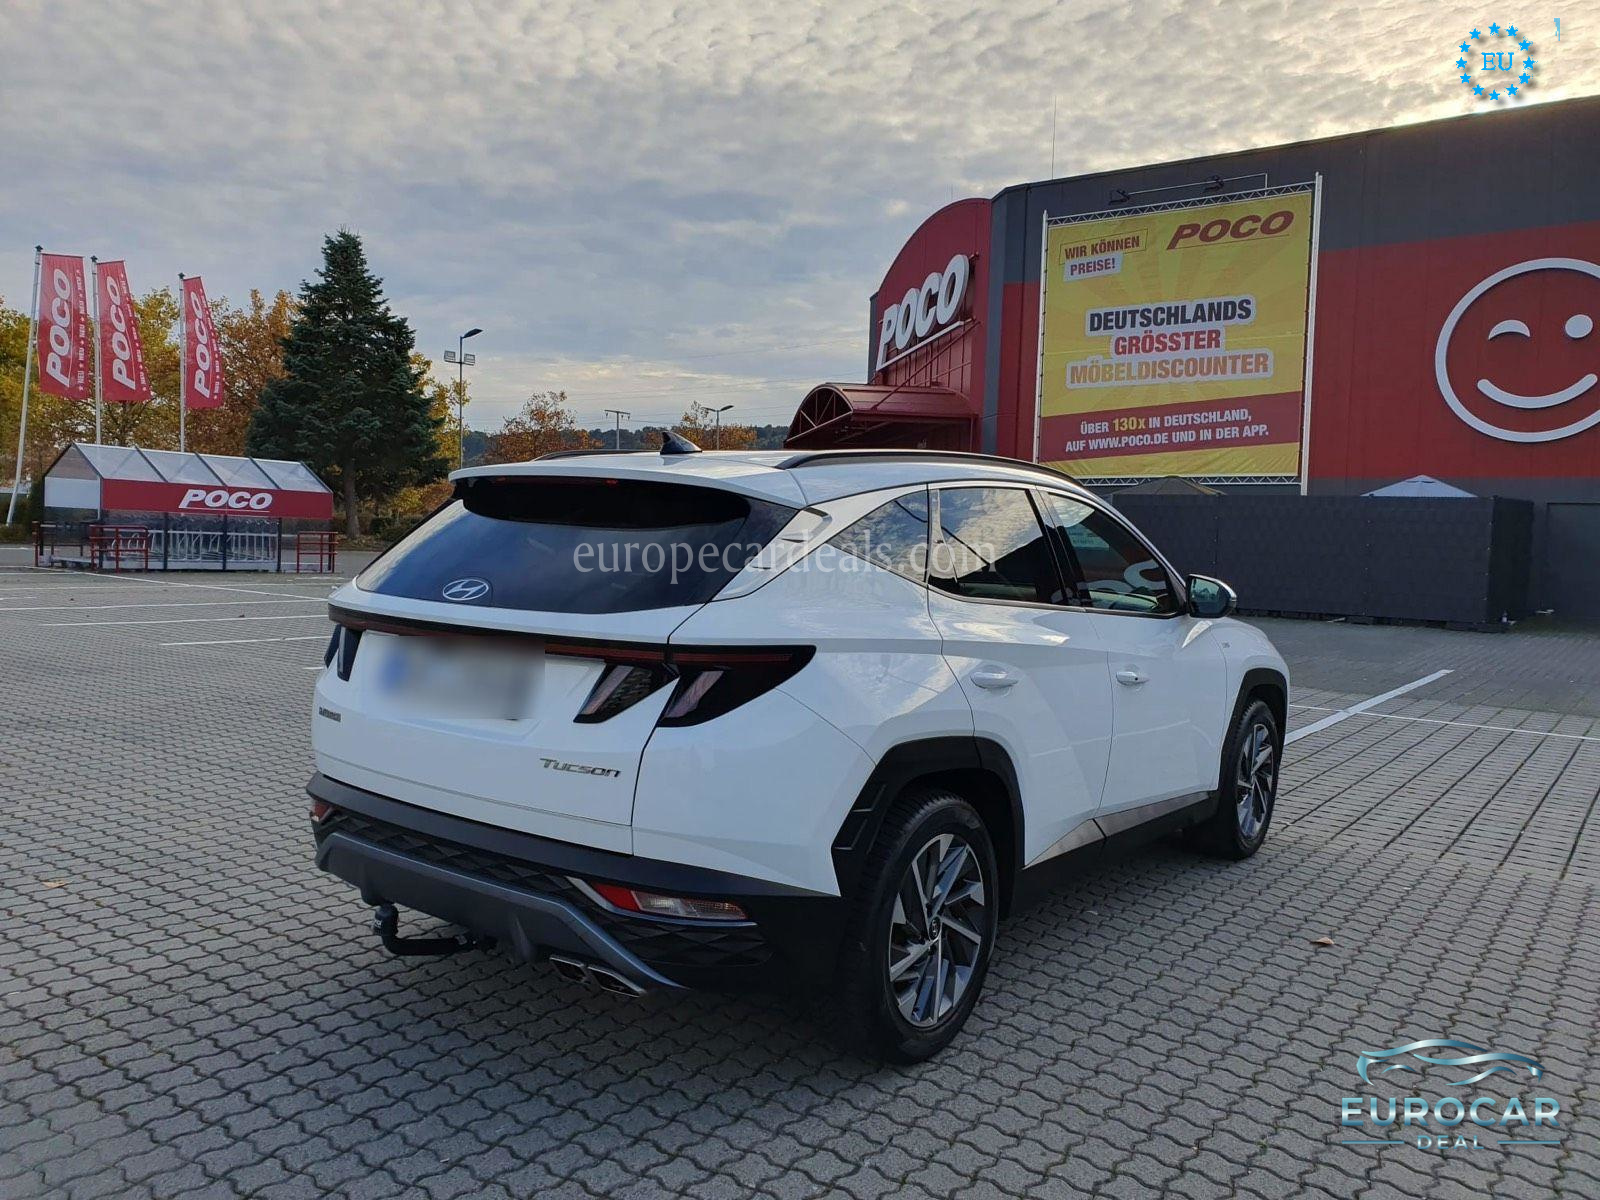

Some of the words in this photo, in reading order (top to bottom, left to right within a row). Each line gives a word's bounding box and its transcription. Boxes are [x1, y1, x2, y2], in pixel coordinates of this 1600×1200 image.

[1167, 210, 1295, 250] POCO
[1064, 245, 1087, 260] WIR
[1091, 235, 1140, 256] KÖNNEN
[1070, 257, 1116, 276] PREISE!
[46, 268, 71, 388] POCO
[876, 254, 970, 372] POCO
[1089, 298, 1252, 332] DEUTSCHLANDS
[106, 275, 136, 390] POCO
[190, 291, 211, 399] POCO
[1114, 329, 1221, 356] GRÖSSTER
[1070, 352, 1269, 384] MÖBELDISCOUNTER
[1080, 421, 1109, 435] ÜBER
[1112, 416, 1146, 432] 130x
[1149, 416, 1160, 428] IN
[1164, 408, 1252, 427] DEUTSCHLAND,
[1065, 440, 1086, 452] AUF
[1089, 434, 1169, 450] WWW.POCO.DE
[1172, 430, 1196, 442] UND
[1200, 428, 1212, 440] IN
[1216, 426, 1240, 439] DER
[1242, 424, 1269, 437] APP.
[178, 489, 273, 510] POCO
